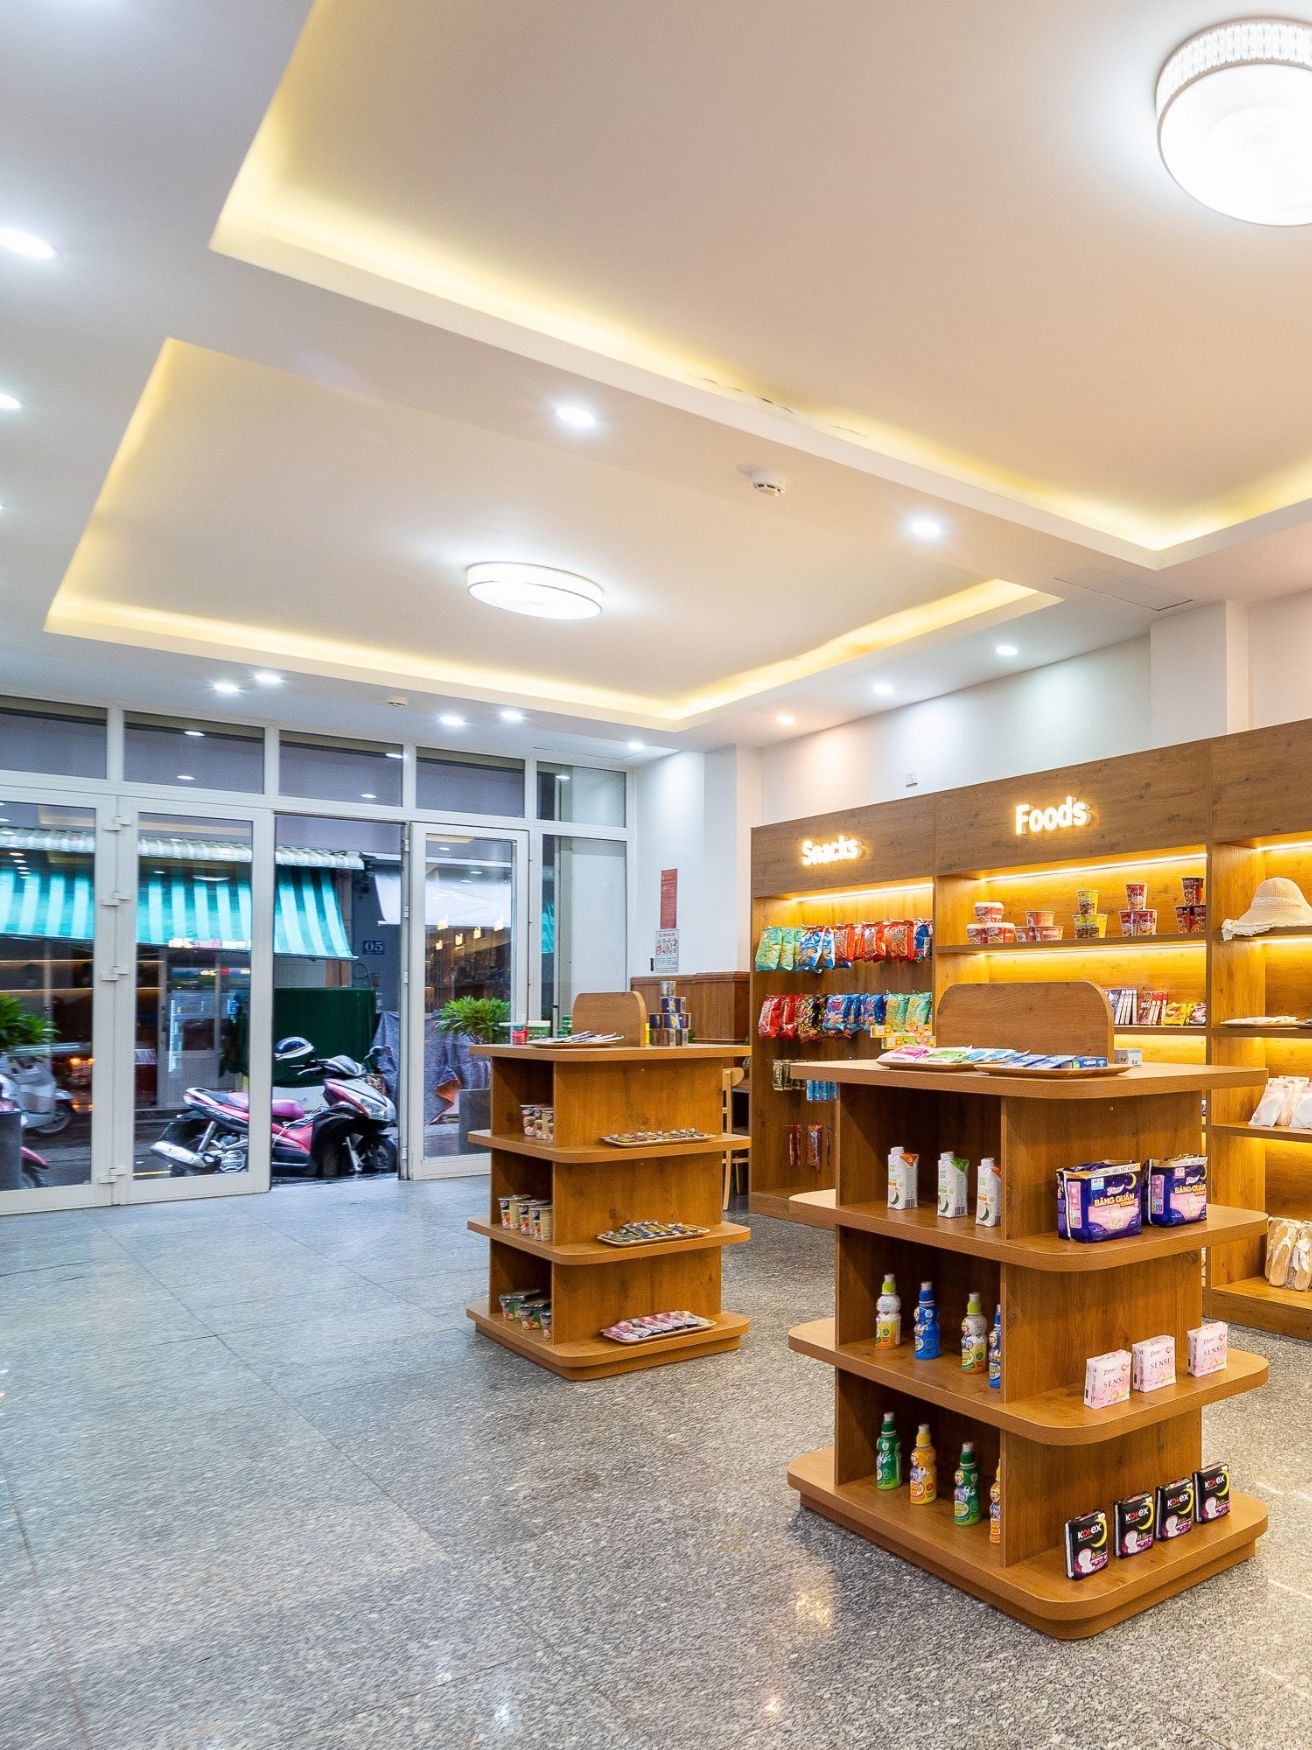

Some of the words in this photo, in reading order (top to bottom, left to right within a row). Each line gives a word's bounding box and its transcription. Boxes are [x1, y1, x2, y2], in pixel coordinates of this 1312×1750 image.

[1015, 796, 1089, 834] Foods
[802, 835, 863, 866] Snacks
[364, 941, 384, 952] 05
